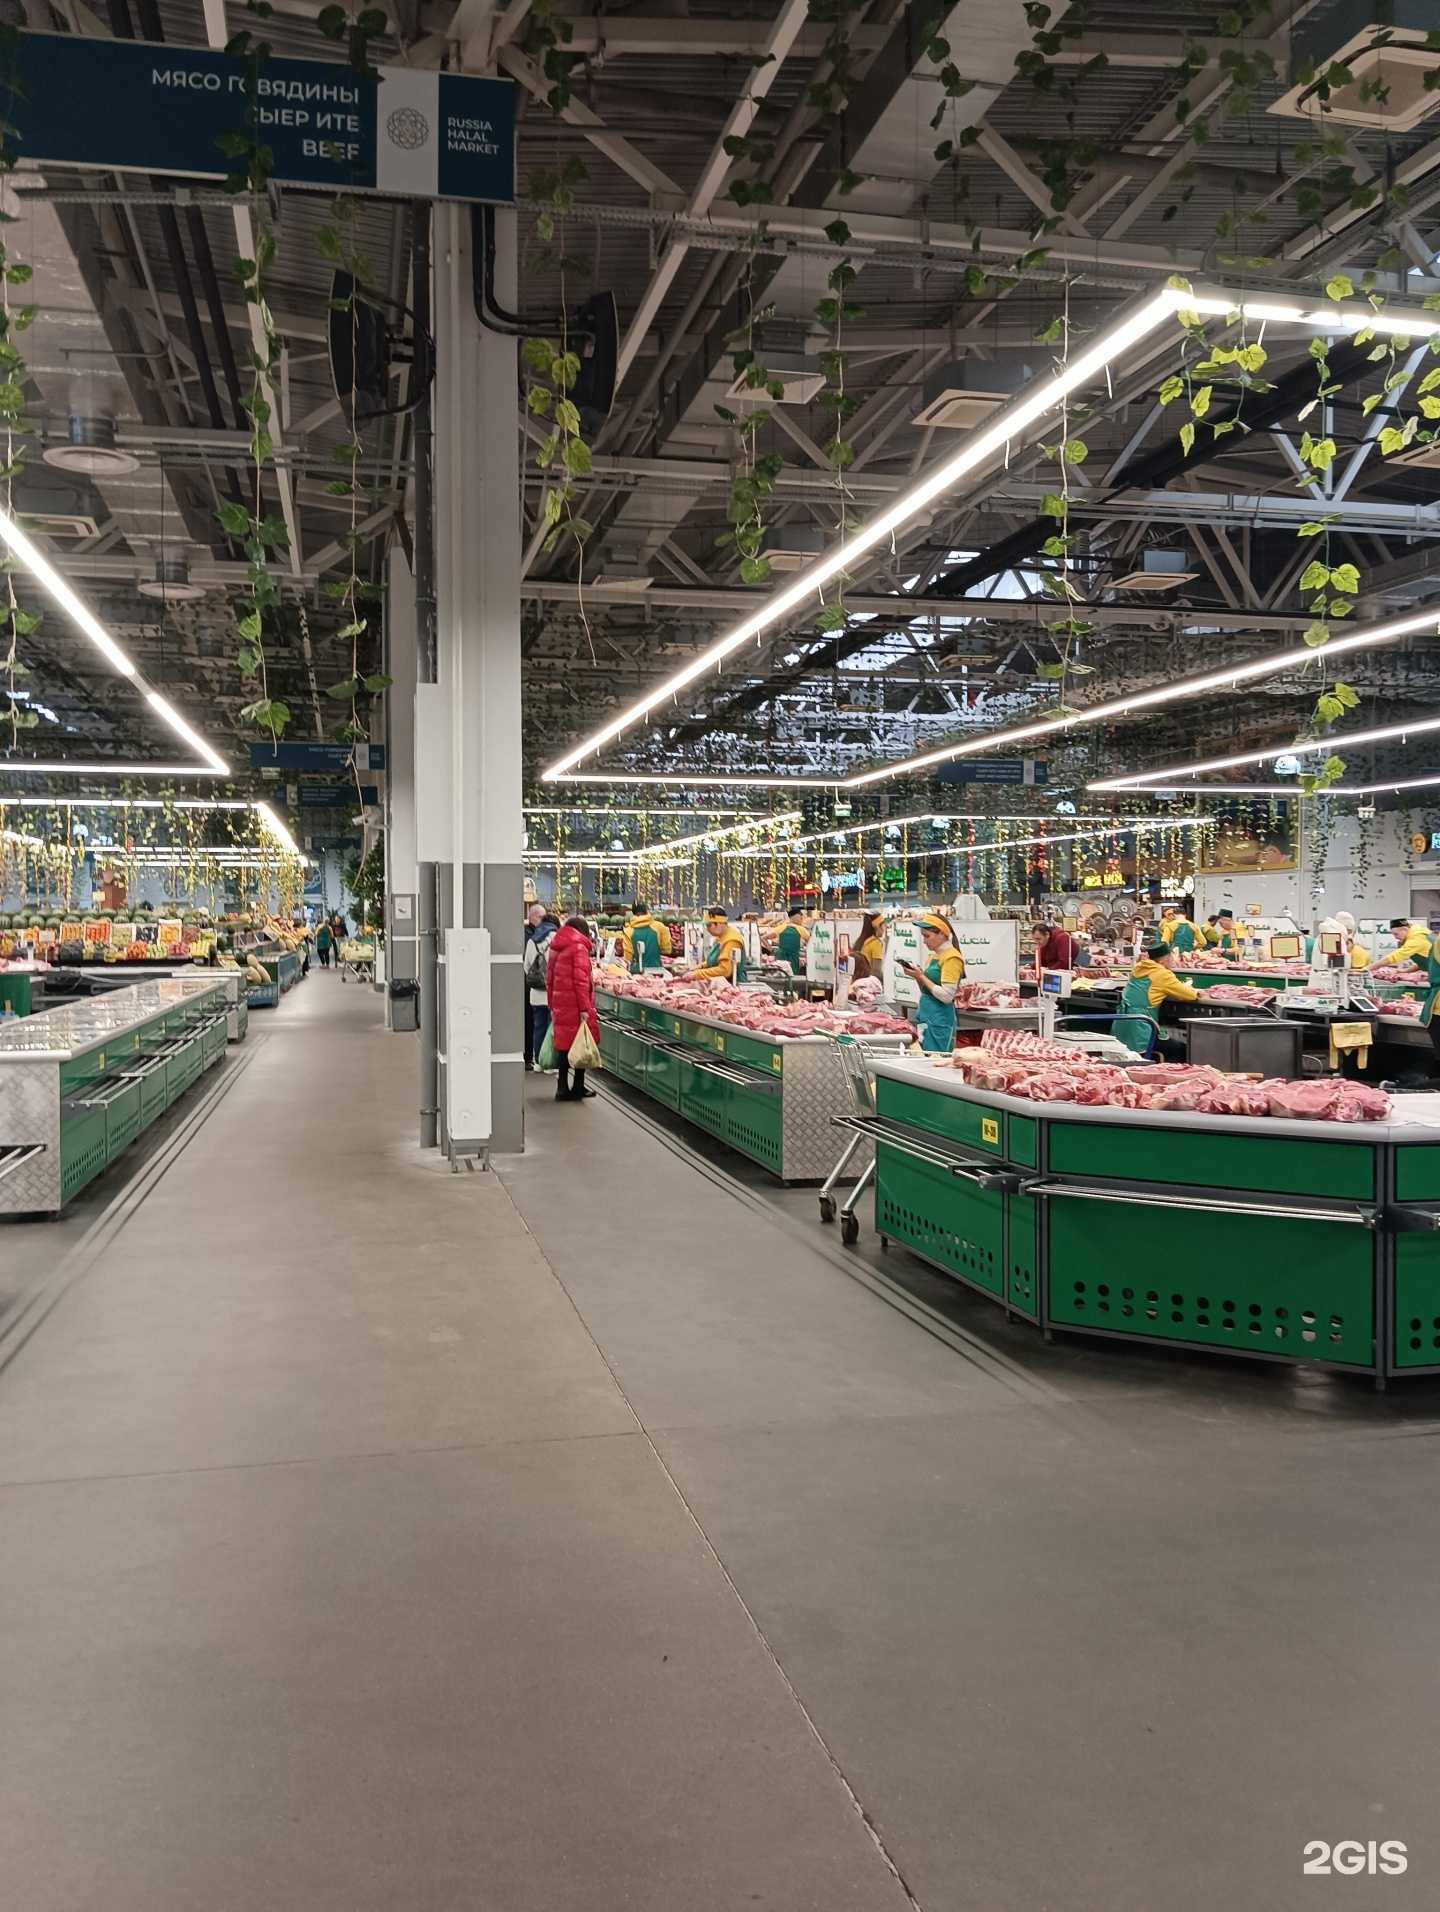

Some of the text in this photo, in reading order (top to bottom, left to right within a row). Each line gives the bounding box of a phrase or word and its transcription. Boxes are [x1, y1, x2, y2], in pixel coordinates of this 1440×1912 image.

[151, 68, 222, 92] МЯСО
[252, 105, 360, 133] ЫЕР ИТЕ
[447, 116, 494, 131] RUSSIA
[447, 128, 489, 143] HALAL
[447, 140, 500, 155] MARKET
